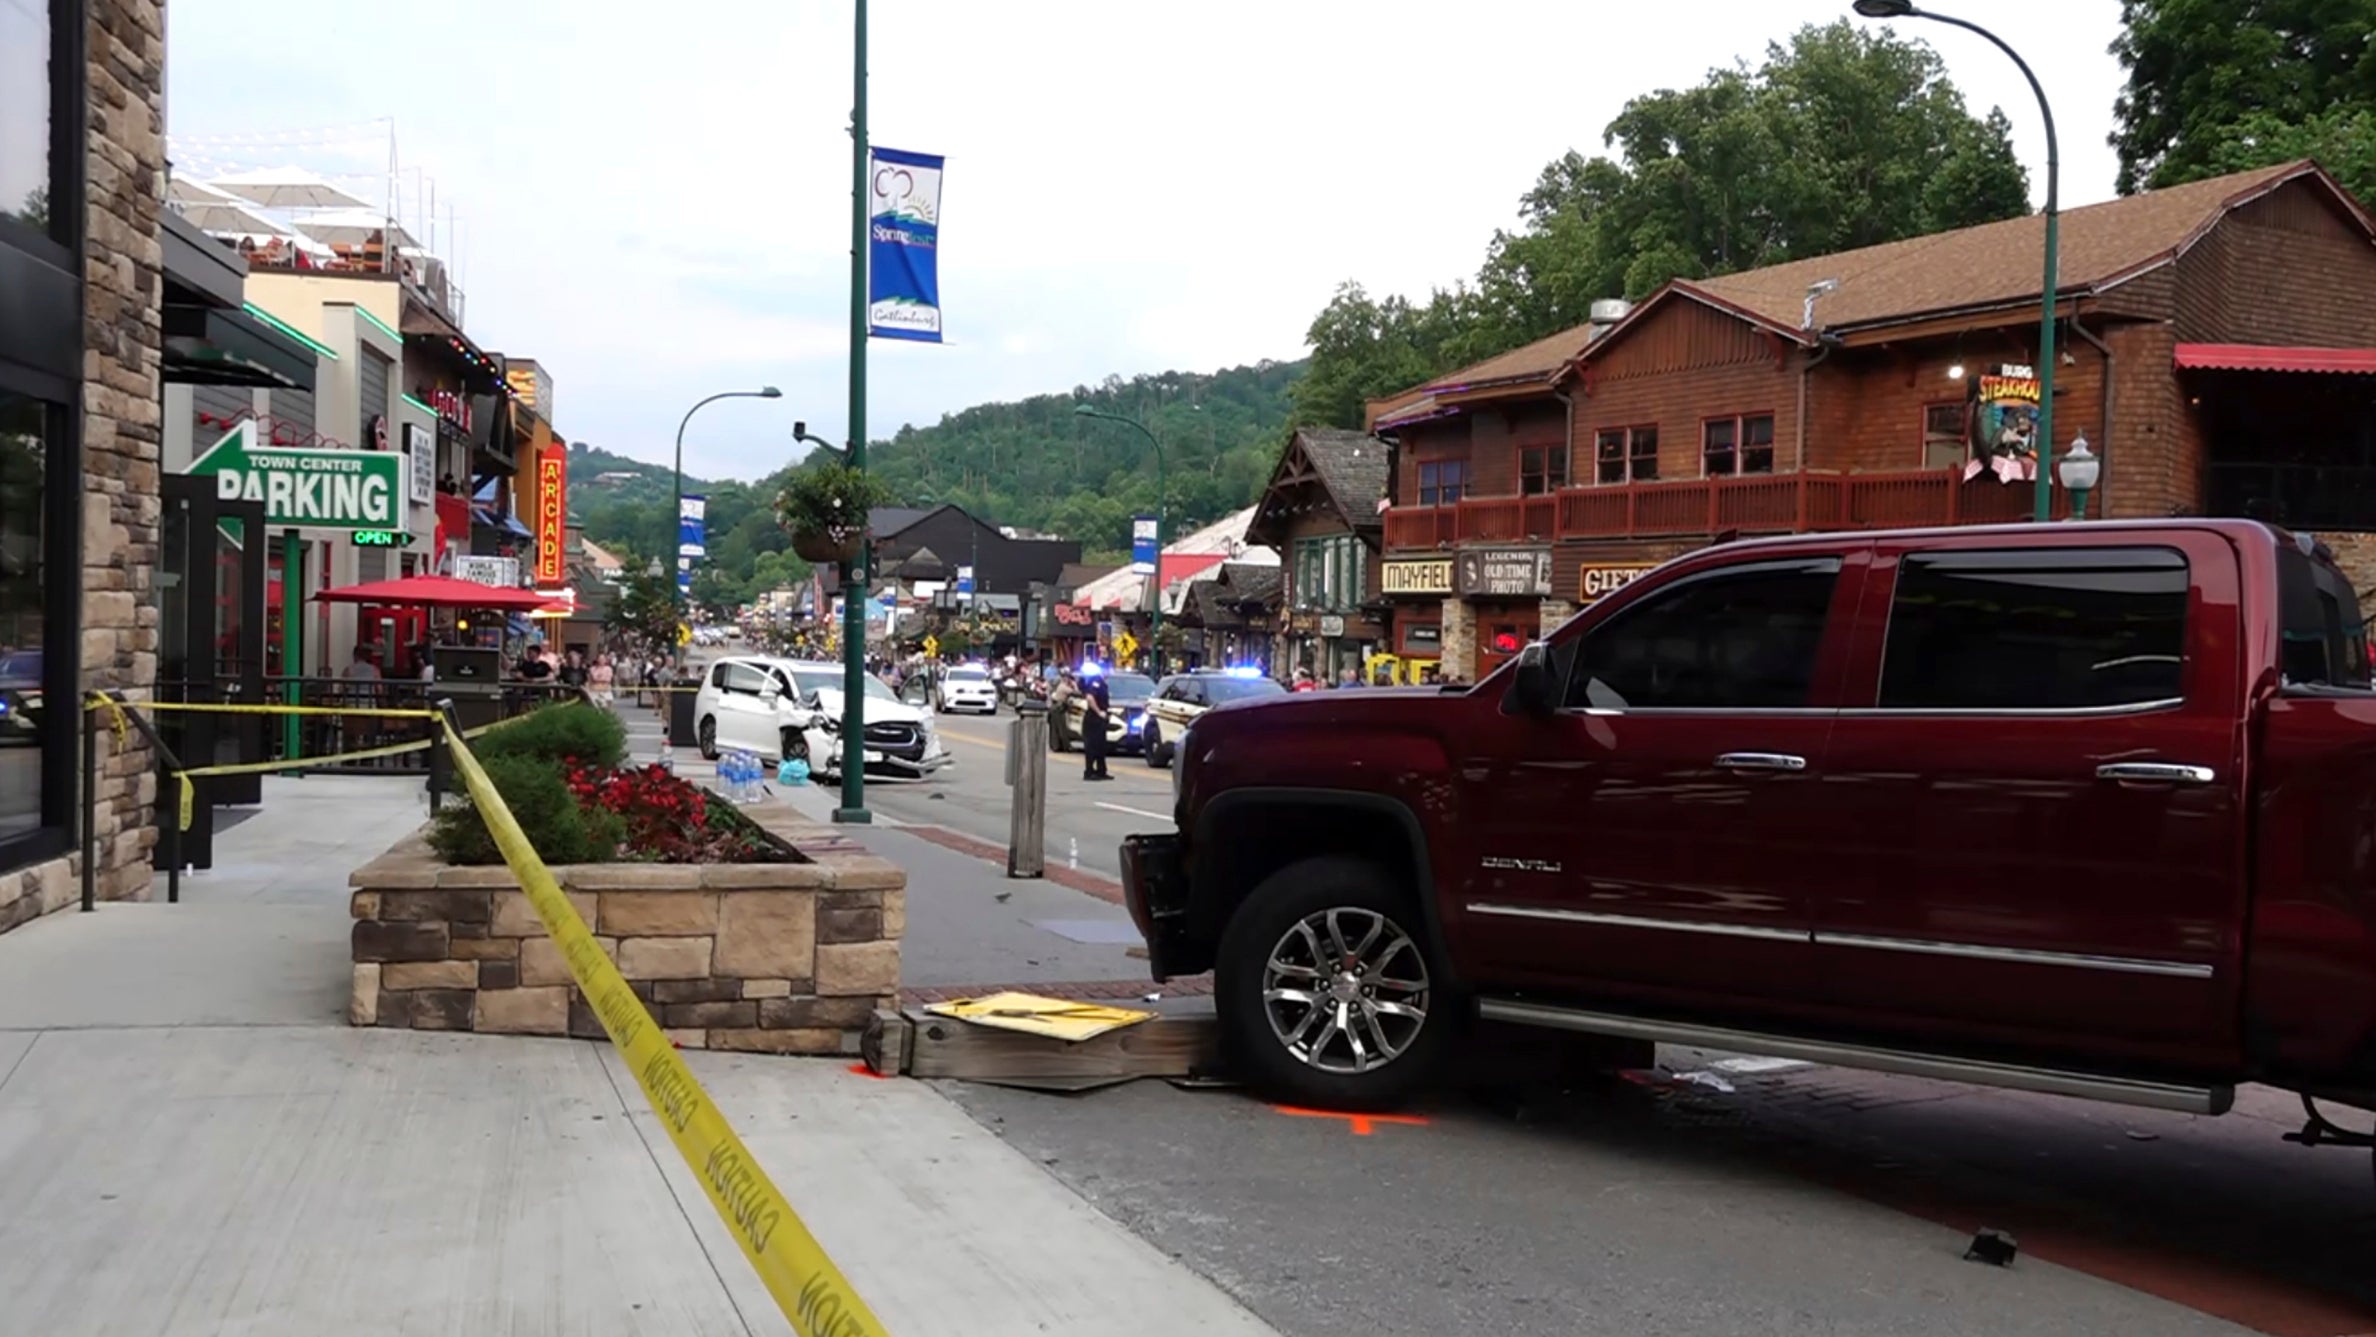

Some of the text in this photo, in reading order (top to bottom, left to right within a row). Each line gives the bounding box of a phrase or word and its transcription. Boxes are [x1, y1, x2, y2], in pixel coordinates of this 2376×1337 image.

[2002, 364, 2033, 379] BURG
[1979, 376, 2041, 401] STEAKHOU
[249, 455, 362, 472] TOWN CENTER
[217, 468, 388, 521] PARKING
[545, 464, 557, 575] ARCADE
[355, 533, 392, 545] OPEN
[1484, 565, 1532, 578] OLD TIME
[1490, 580, 1525, 593] PHOTO
[1482, 857, 1561, 872] DENALI
